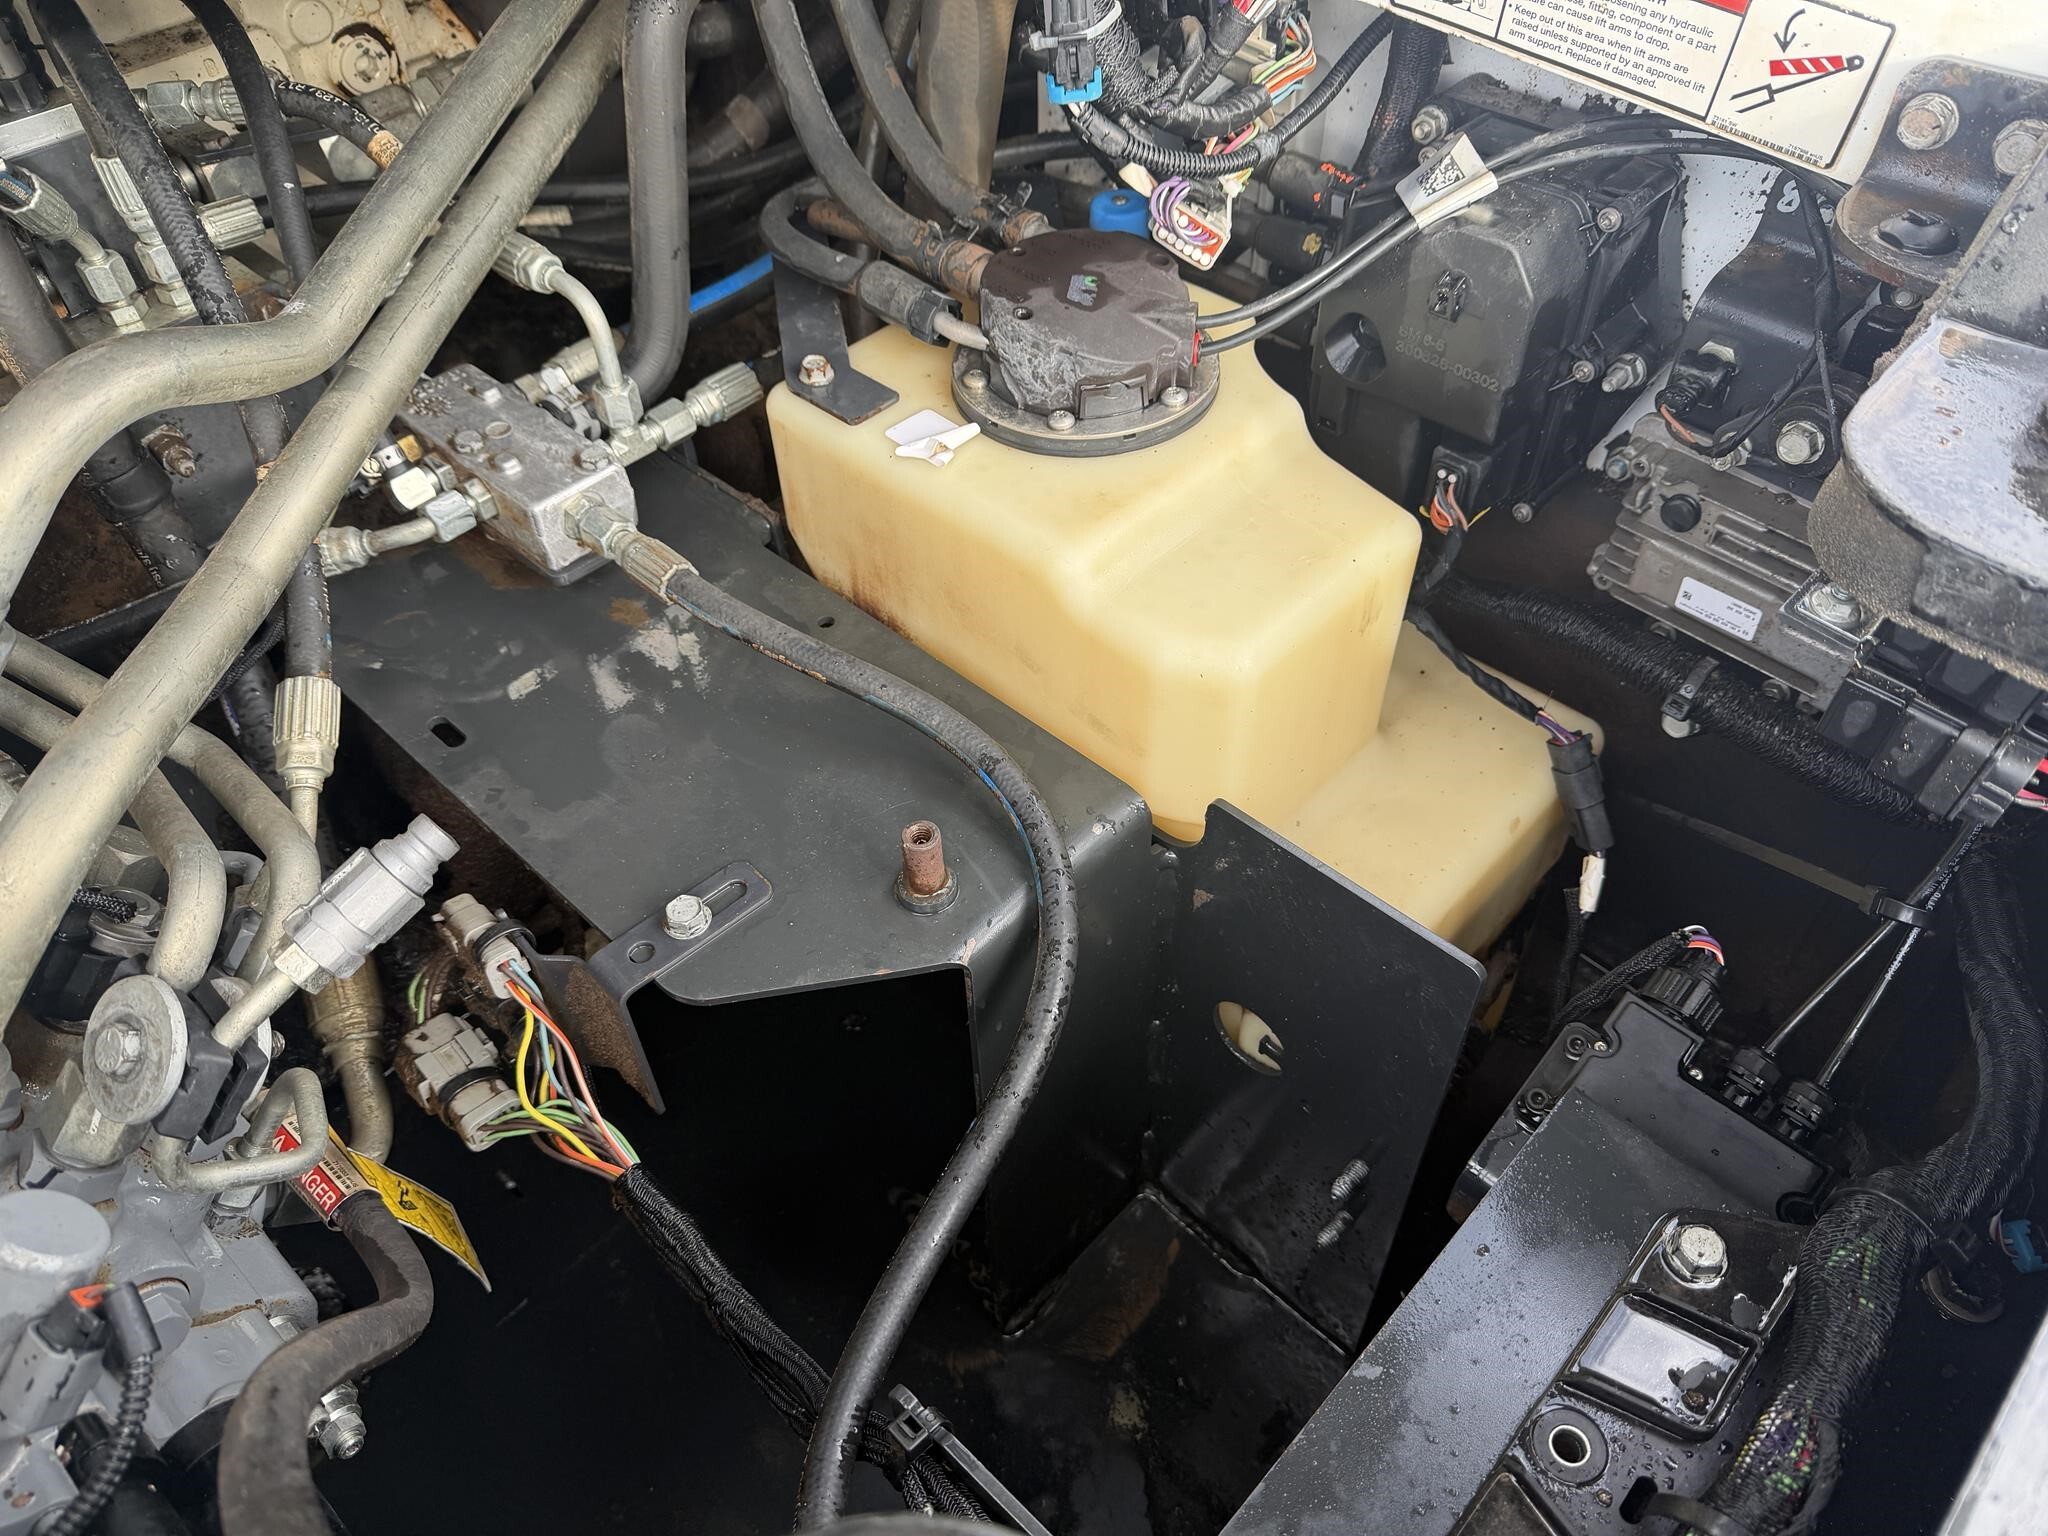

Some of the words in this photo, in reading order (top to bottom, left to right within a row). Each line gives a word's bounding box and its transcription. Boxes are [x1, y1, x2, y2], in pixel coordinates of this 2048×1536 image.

[1514, 3, 1538, 19] Keep
[1539, 13, 1553, 25] out
[1555, 20, 1566, 29] of
[1567, 22, 1583, 36] this
[1585, 31, 1605, 44] area
[1607, 38, 1632, 53] when
[1634, 47, 1646, 59] lift
[1648, 55, 1671, 68] arms
[1673, 63, 1689, 74] are
[1547, 2, 1564, 12] can
[1566, 8, 1593, 22] cause
[1594, 16, 1607, 28] lift
[1608, 23, 1632, 37] arms
[1634, 29, 1644, 40] to
[1646, 33, 1670, 51] drop.
[1620, 13, 1674, 38] component
[1675, 32, 1687, 42] or
[1687, 37, 1694, 45] a
[1695, 41, 1717, 53] part
[1649, 11, 1668, 23] any
[1669, 15, 1714, 38] hydraulic
[1508, 28, 1526, 40] arm
[1527, 35, 1563, 54] support.
[1565, 48, 1602, 68] Replace
[1603, 62, 1611, 71] if
[1612, 66, 1657, 89] damaged.
[1512, 16, 1539, 32] raised
[1540, 26, 1569, 43] unless
[1570, 38, 1617, 61] supported
[1619, 54, 1631, 67] by
[1632, 61, 1644, 71] an
[1646, 66, 1691, 88] approved
[1693, 82, 1706, 94] lift
